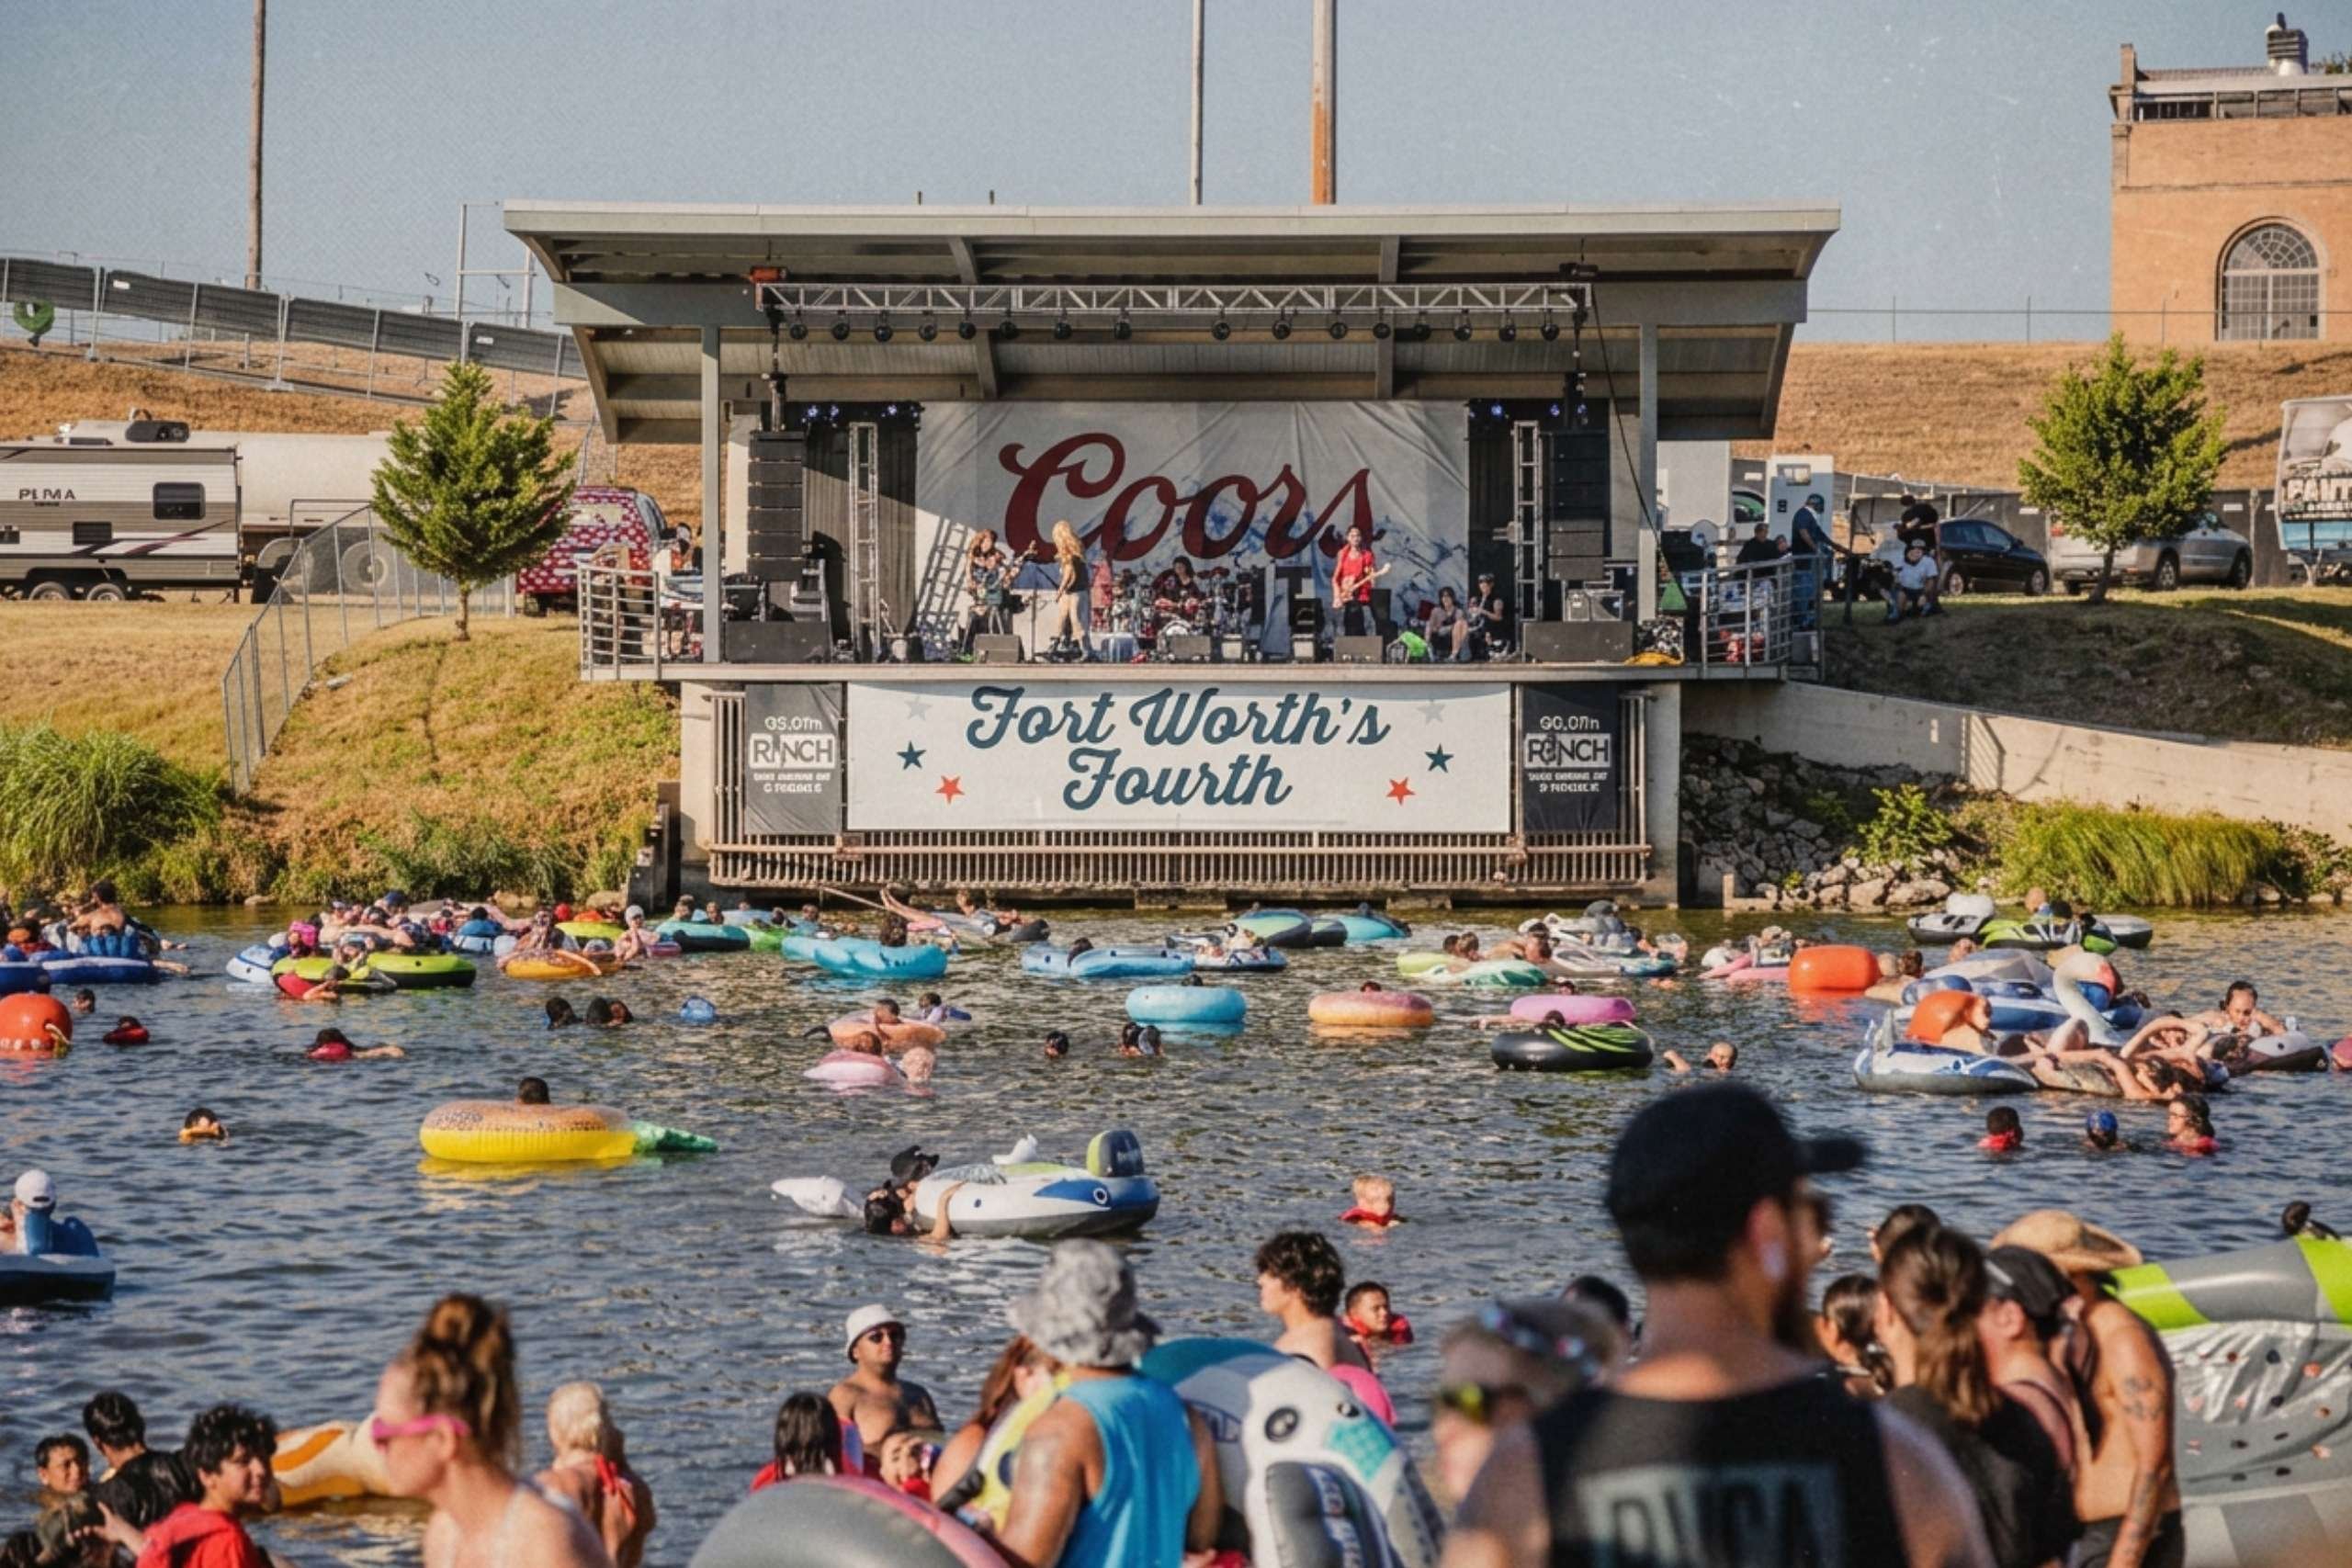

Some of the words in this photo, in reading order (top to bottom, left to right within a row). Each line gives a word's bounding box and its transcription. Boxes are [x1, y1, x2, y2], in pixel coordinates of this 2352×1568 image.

[999, 433, 1382, 562] Coors
[967, 685, 1116, 749] Fort
[1129, 686, 1392, 746] Worth's
[1063, 747, 1293, 810] Fourth
